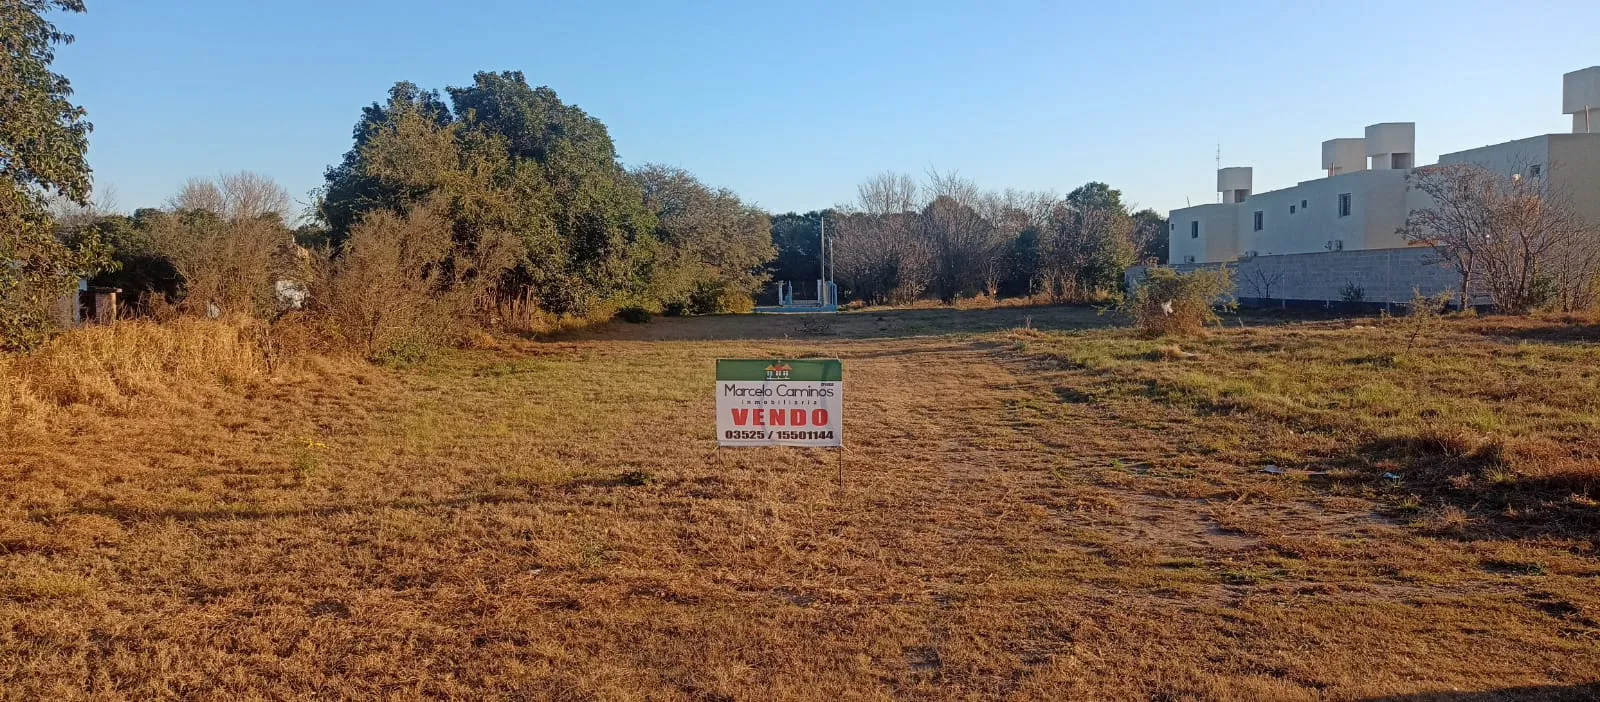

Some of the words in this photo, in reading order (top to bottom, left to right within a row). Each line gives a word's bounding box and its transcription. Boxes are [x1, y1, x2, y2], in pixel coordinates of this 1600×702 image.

[724, 384, 772, 397] Marcelo
[776, 384, 834, 397] Caminos
[731, 408, 828, 426] VENDO
[725, 430, 765, 440] 03525
[767, 430, 773, 440] /
[776, 430, 834, 440] 15501144
